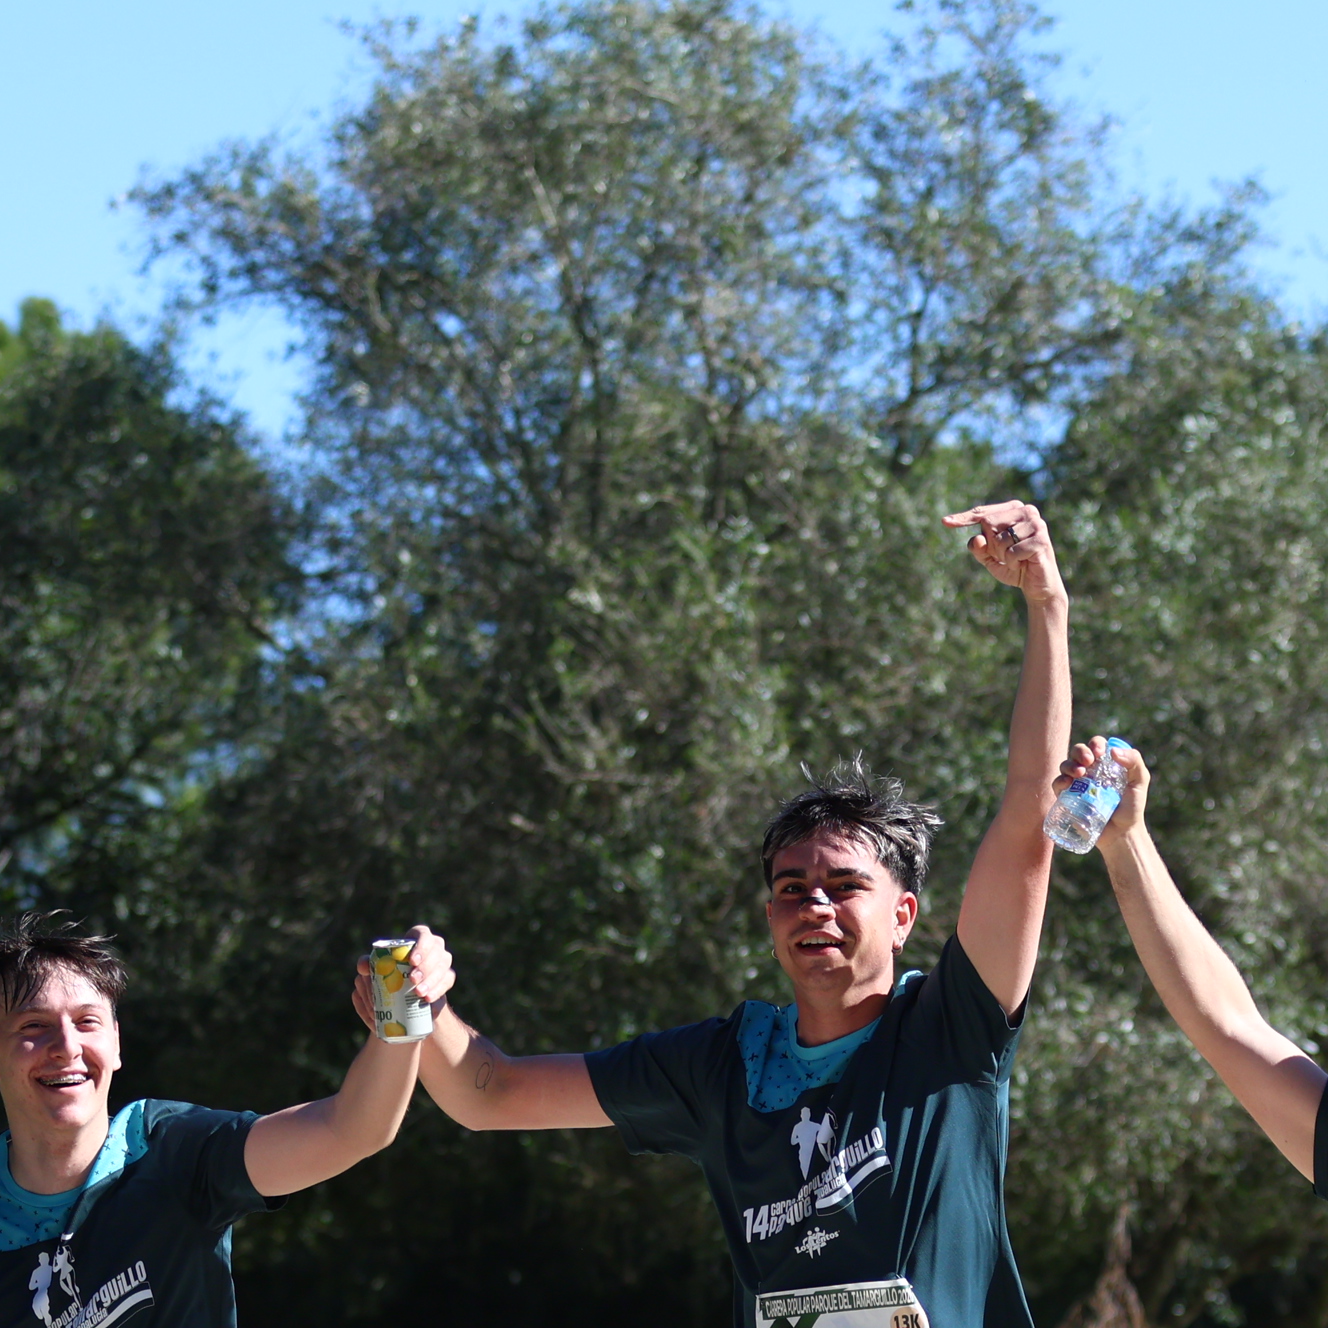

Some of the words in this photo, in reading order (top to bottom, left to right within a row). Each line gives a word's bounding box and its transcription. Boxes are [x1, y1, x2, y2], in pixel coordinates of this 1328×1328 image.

[743, 1204, 769, 1243] 14
[765, 1299, 786, 1317] CARRERA
[787, 1296, 811, 1315] POPULAR
[810, 1294, 838, 1314] PARQUE
[838, 1292, 851, 1310] DEL
[851, 1289, 897, 1308] TAMARGUILLO
